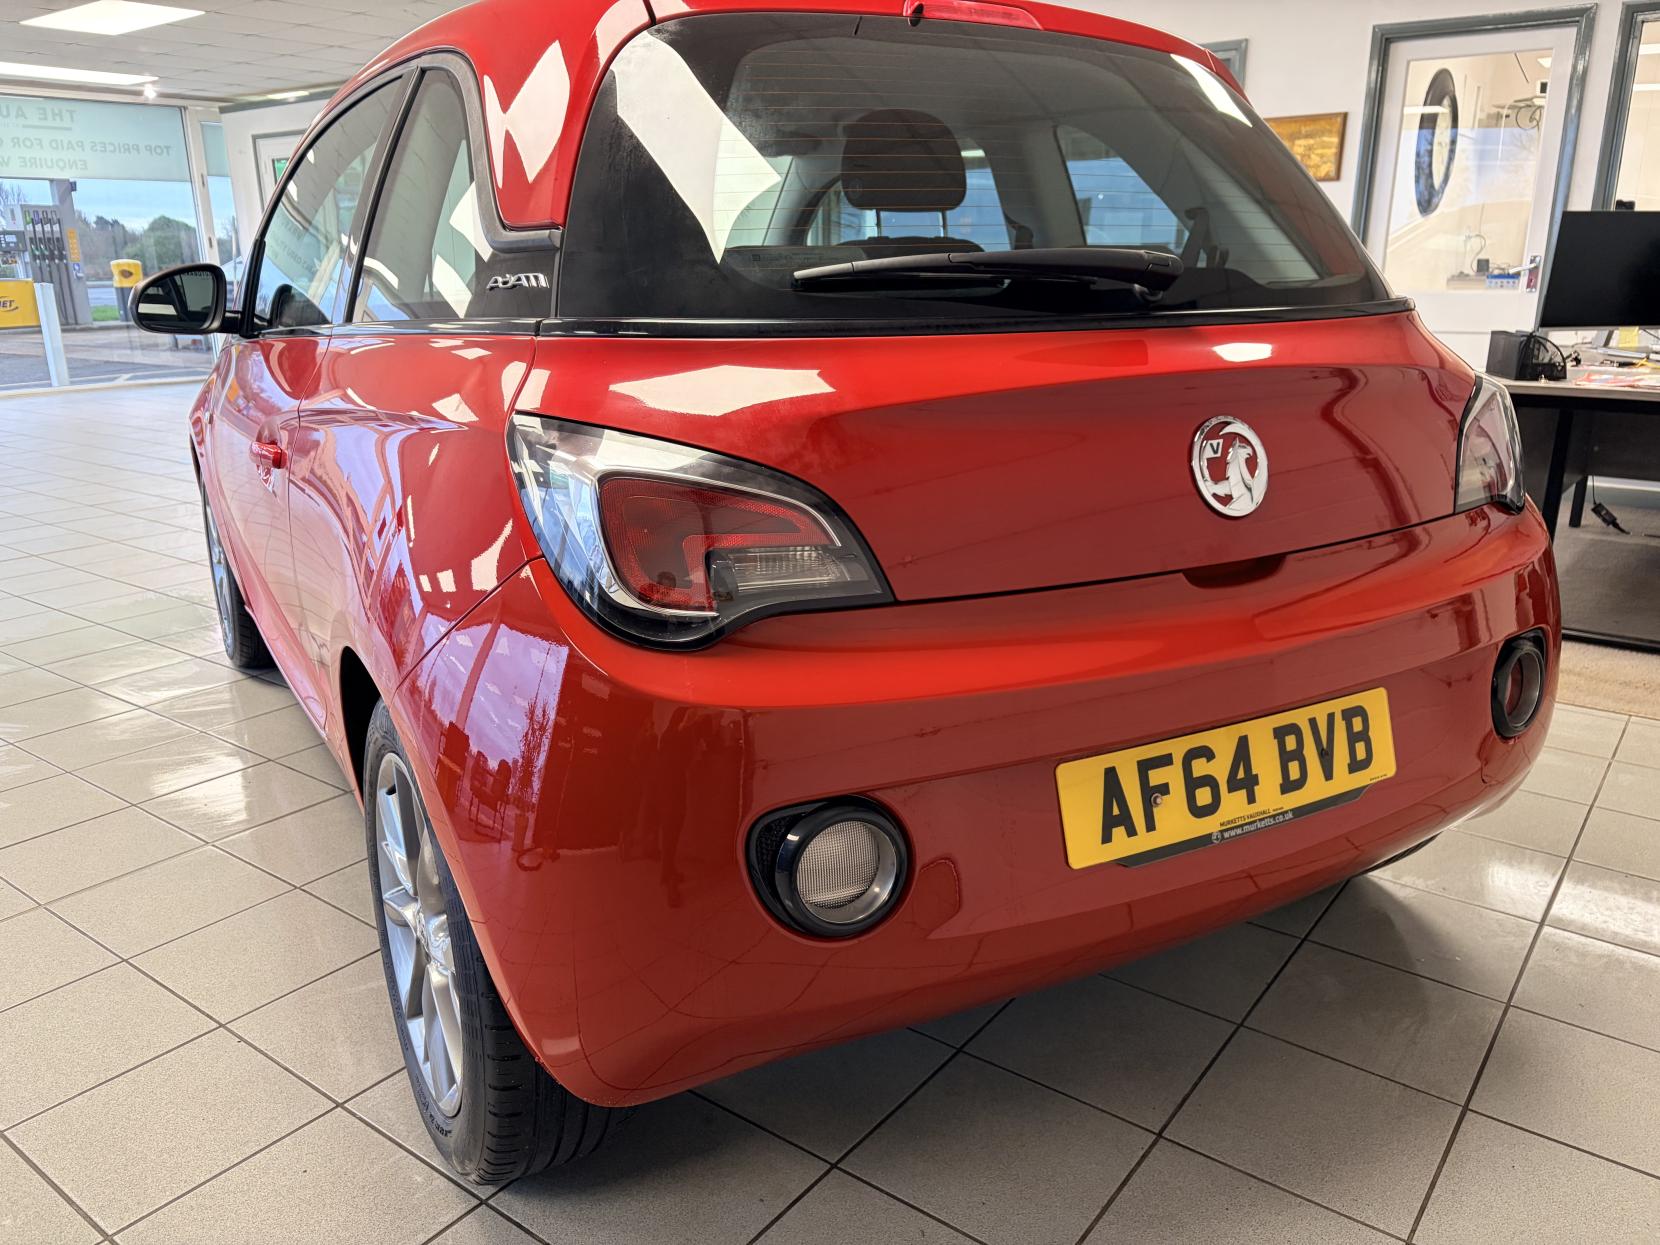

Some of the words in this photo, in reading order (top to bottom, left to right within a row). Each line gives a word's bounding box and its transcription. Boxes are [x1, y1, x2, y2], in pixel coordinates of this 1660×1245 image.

[0, 299, 16, 308] ET
[1101, 735, 1260, 845] AF64
[1272, 704, 1374, 796] BVB
[1223, 810, 1294, 839] www.murketts.co.uk
